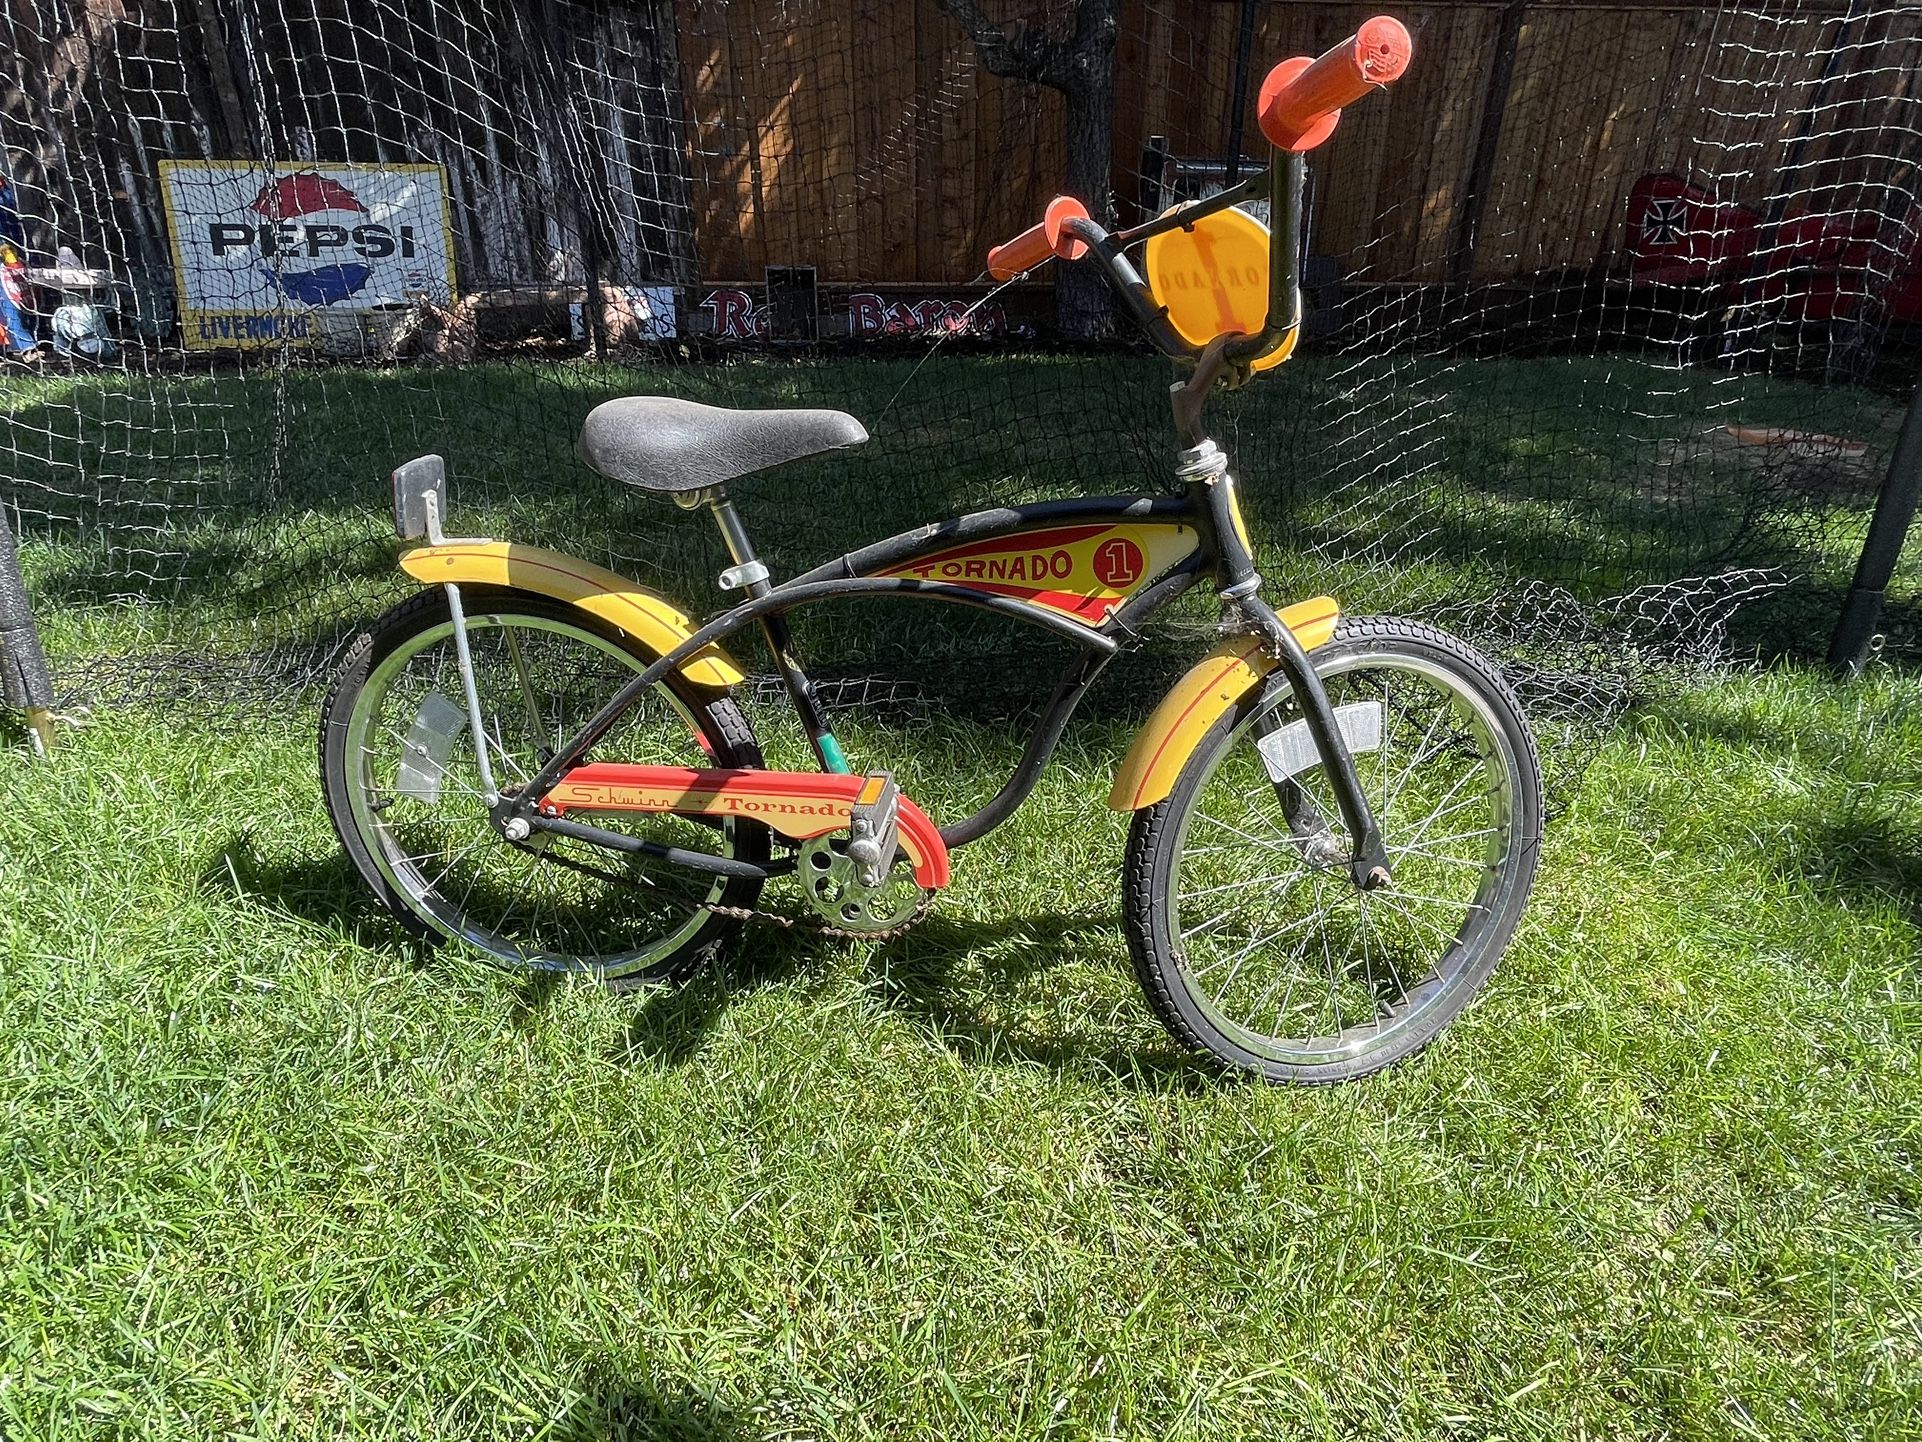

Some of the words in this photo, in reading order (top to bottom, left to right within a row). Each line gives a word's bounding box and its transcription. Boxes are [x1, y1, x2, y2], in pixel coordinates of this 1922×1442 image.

[209, 223, 415, 258] PEPSI
[849, 293, 1008, 337] Baron
[912, 549, 1073, 581] TORNADO
[1105, 542, 1134, 583] 1
[558, 786, 677, 808] Schwinn
[723, 796, 853, 818] Tornado
